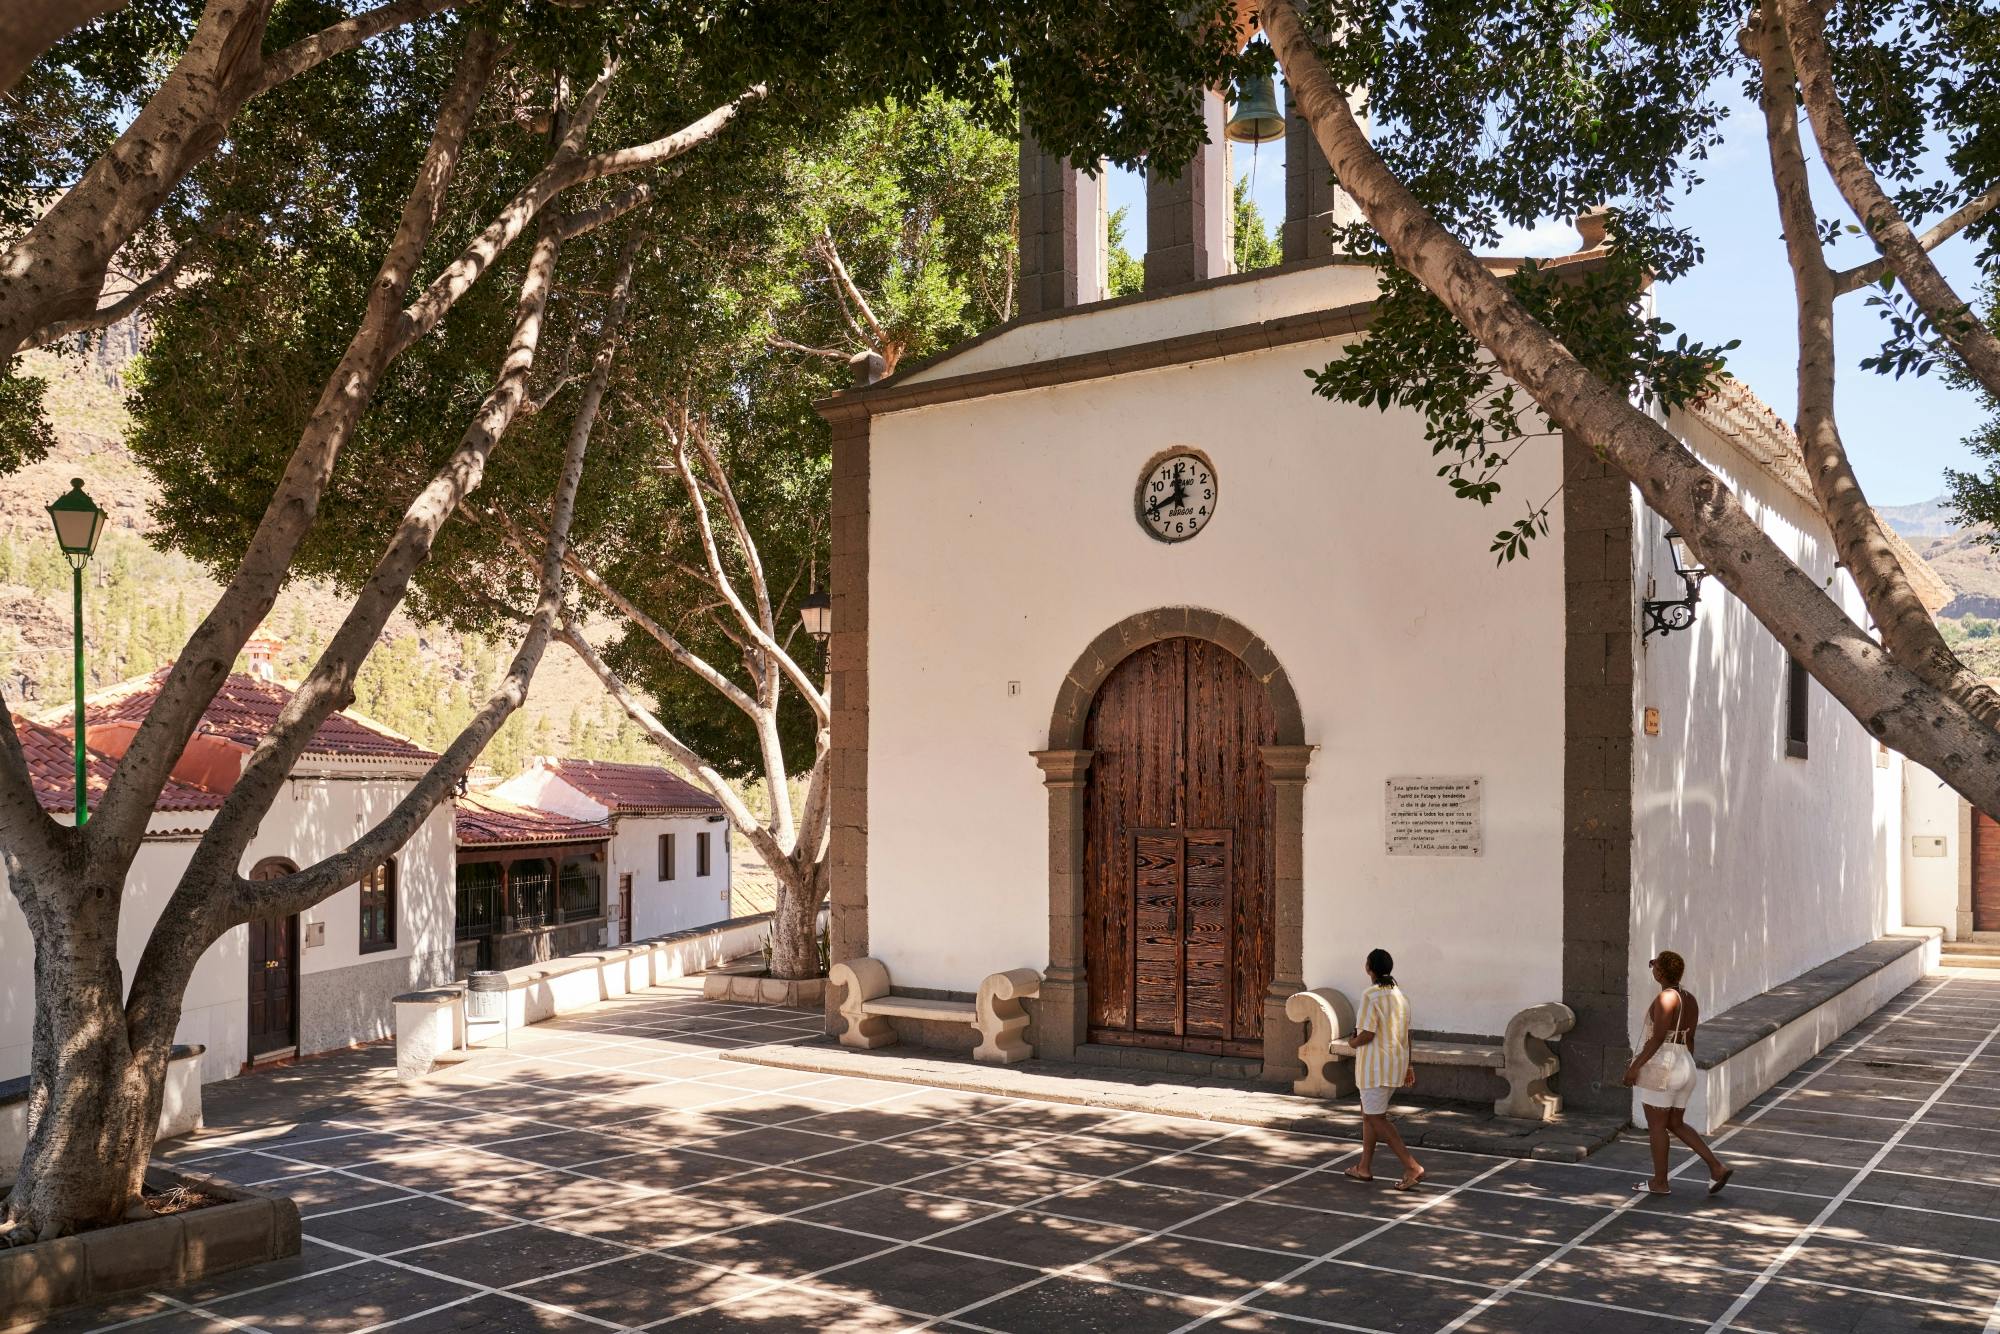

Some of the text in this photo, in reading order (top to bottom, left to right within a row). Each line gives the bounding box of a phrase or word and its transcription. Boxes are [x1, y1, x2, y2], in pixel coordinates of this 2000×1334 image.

[1173, 462, 1185, 473] 12
[1190, 465, 1195, 476] 1
[1161, 469, 1170, 480] 11
[1200, 473, 1207, 484] 2
[1151, 481, 1164, 492] 10
[1204, 489, 1211, 499] 3
[1150, 496, 1157, 508] 9
[1153, 509, 1160, 522] 8
[1169, 508, 1193, 517] BURGOS
[1199, 506, 1206, 516] 4
[1163, 521, 1171, 532] 7
[1176, 522, 1183, 533] 6
[1189, 517, 1197, 529] 5
